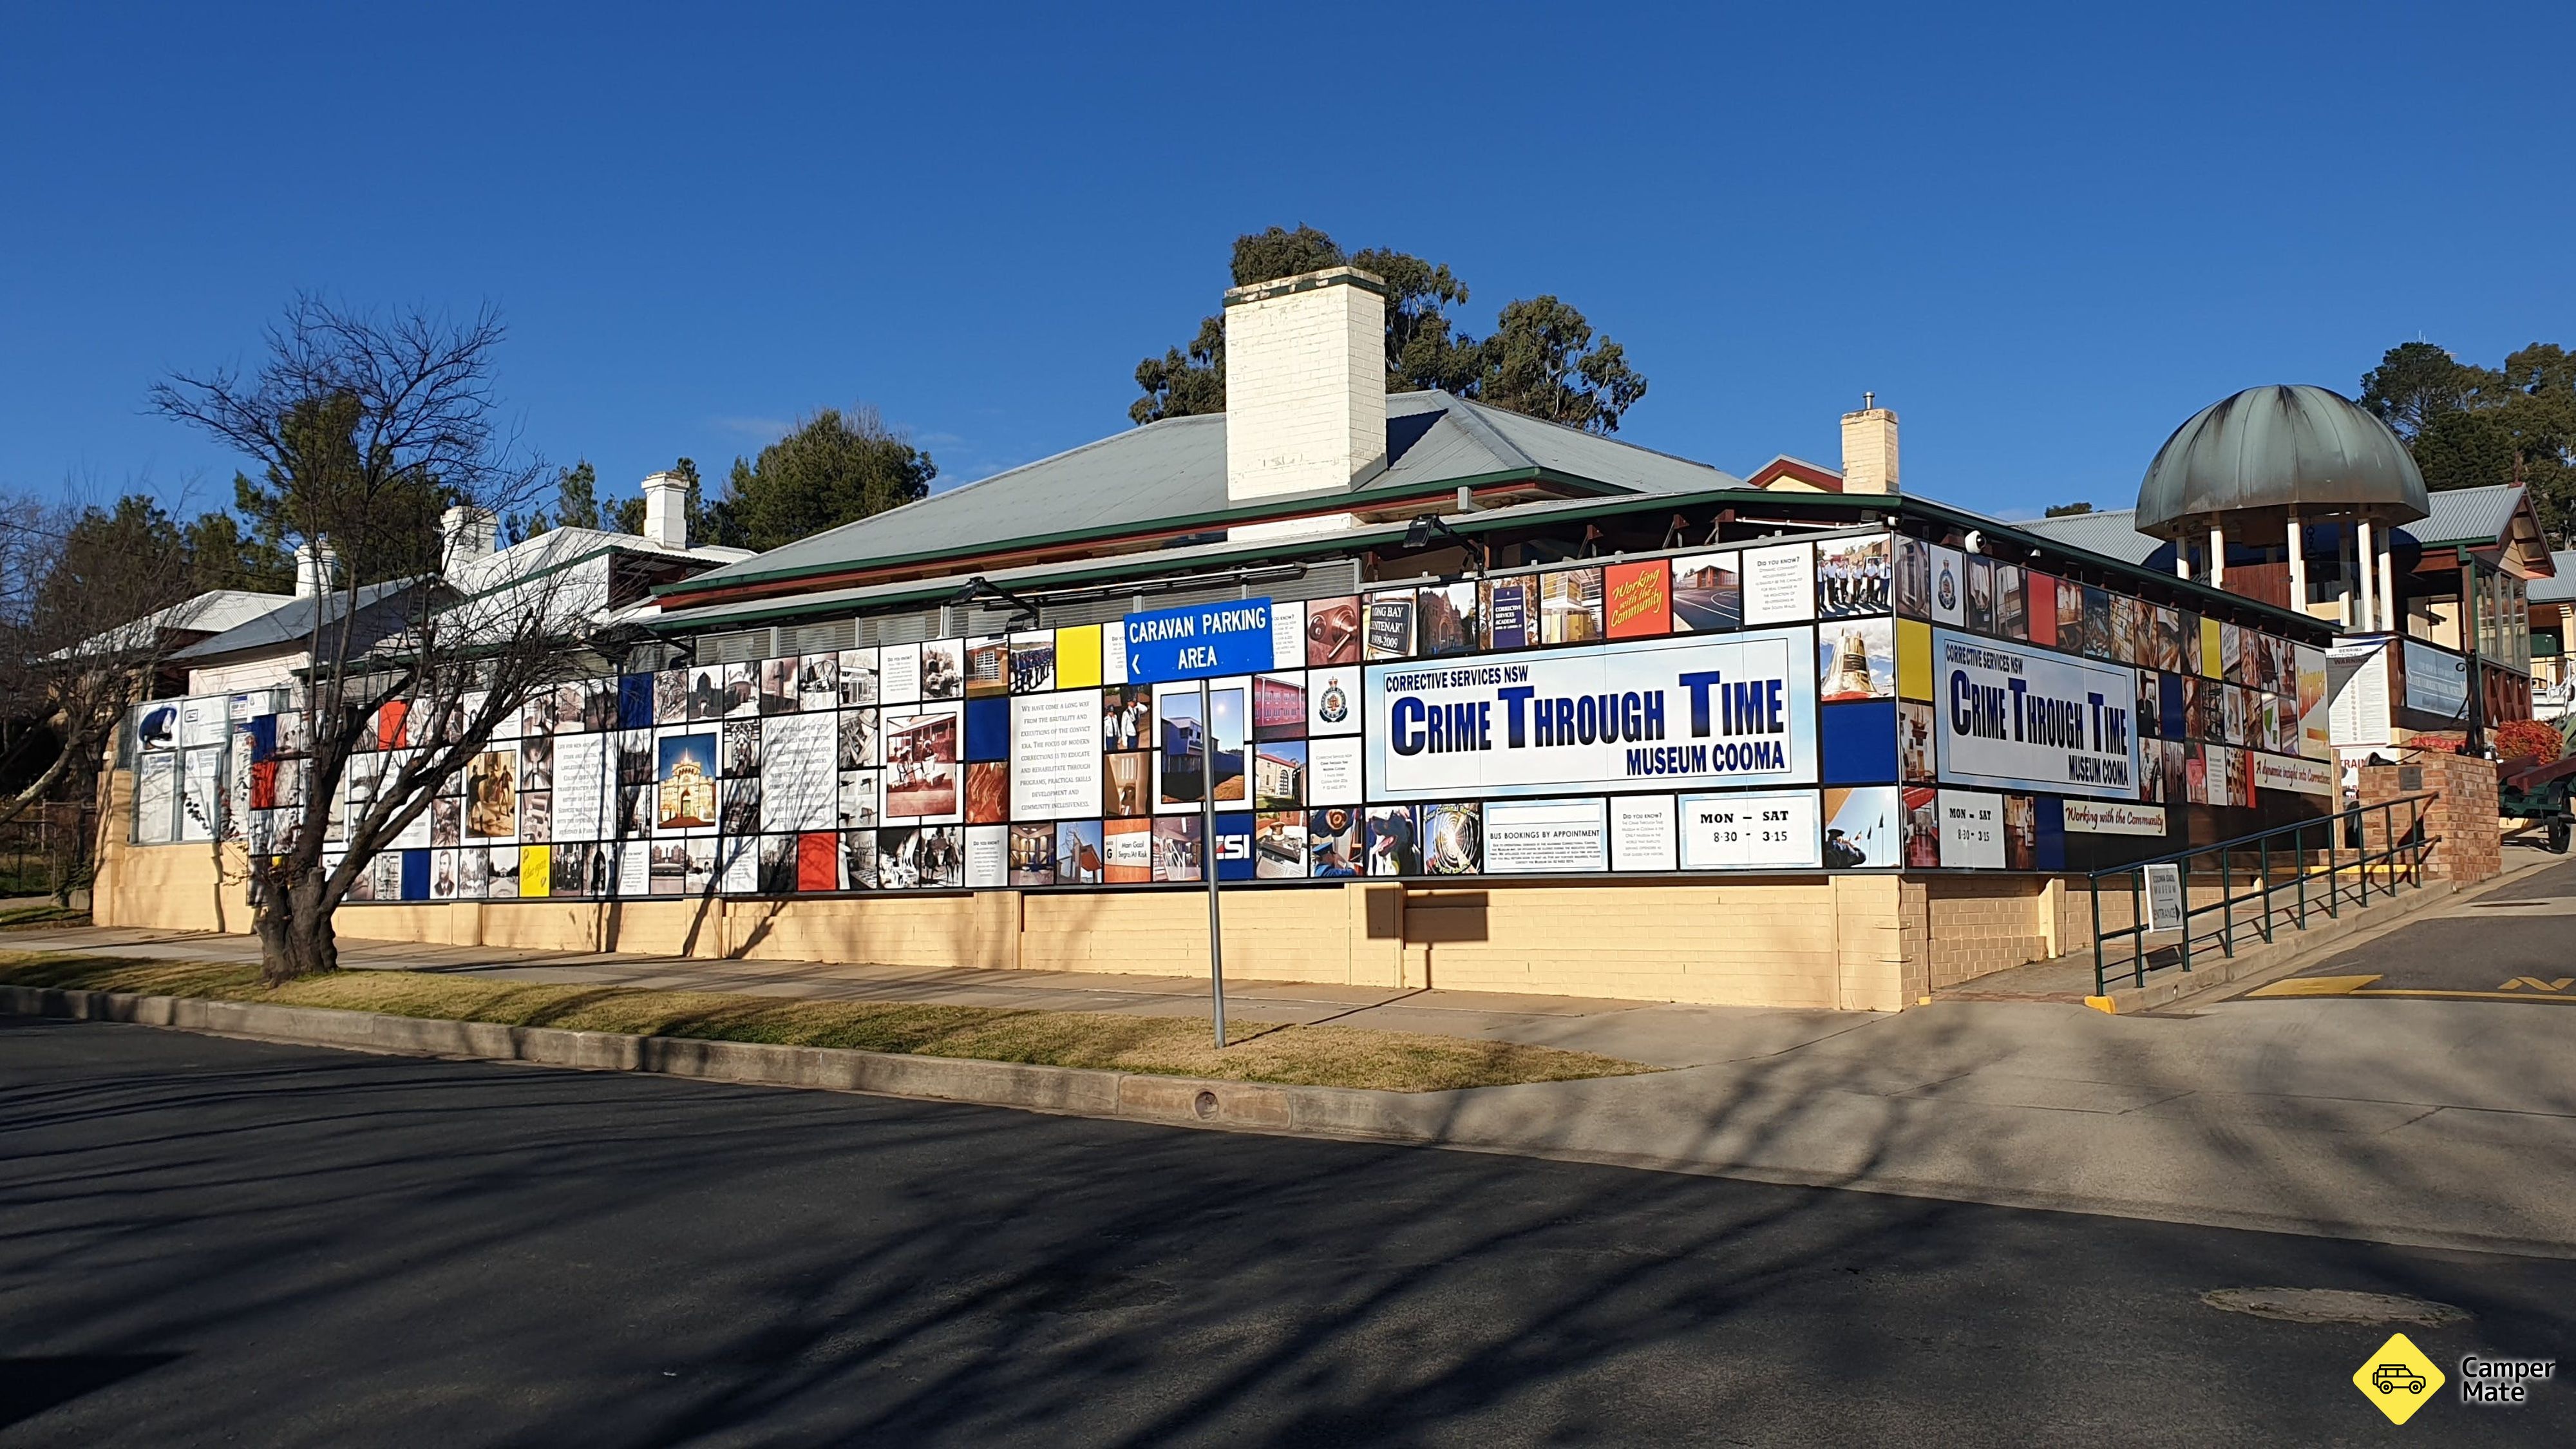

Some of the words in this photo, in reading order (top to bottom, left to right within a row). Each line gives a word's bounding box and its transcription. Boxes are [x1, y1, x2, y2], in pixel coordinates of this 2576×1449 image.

[1612, 568, 1660, 601] Working
[1611, 588, 1662, 627] Community
[1620, 589, 1638, 610] with
[1639, 585, 1651, 601] the
[1129, 616, 1194, 643] CARAVAN
[1202, 607, 1266, 635] PARKING
[1372, 607, 1387, 617] LONG
[1387, 607, 1403, 618] BAY
[1178, 646, 1217, 670] AREA
[1946, 643, 1982, 667] CORRECTIVE
[1983, 652, 2009, 672] SERVICES
[2011, 656, 2023, 675] NSW
[1386, 671, 1448, 692] CORRECTIVE
[1450, 668, 1501, 687] SERVICES
[1504, 665, 1528, 683] NSW
[1392, 696, 1492, 756] CRIME
[1497, 685, 1665, 748] THROUGH
[1679, 670, 1784, 739] TIME
[1951, 669, 2007, 740] CRIME
[2008, 677, 2084, 750] THROUGH
[2088, 692, 2127, 755] TIME
[1032, 765, 1066, 773] REHABILITATE
[1626, 744, 1707, 776] MUSEUM
[1712, 740, 1785, 772] COOMA
[2069, 755, 2101, 784] MUSEUM
[2103, 757, 2128, 786] COOMA
[2256, 761, 2262, 774] A
[2262, 758, 2282, 784] dynamic
[2283, 763, 2298, 787] insight
[2298, 767, 2307, 781] into
[2307, 768, 2331, 785] Corrections
[1437, 804, 1459, 814] Criminal
[1460, 807, 1479, 821] Record
[1700, 813, 1734, 824] MON
[1763, 810, 1788, 821] SAT
[1949, 808, 1966, 819] MON
[1979, 809, 1991, 820] SAT
[2065, 806, 2098, 829] Working
[2099, 808, 2114, 824] with
[2116, 808, 2125, 824] the
[2127, 811, 2163, 833] Community
[1504, 831, 1539, 839] BOOKINGS
[1553, 829, 1599, 838] APPOINTMENT
[1107, 848, 1113, 859] G
[1138, 849, 1148, 858] Risk
[2154, 885, 2176, 895] MUSEUM
[2154, 907, 2177, 920] ENTRANCE
